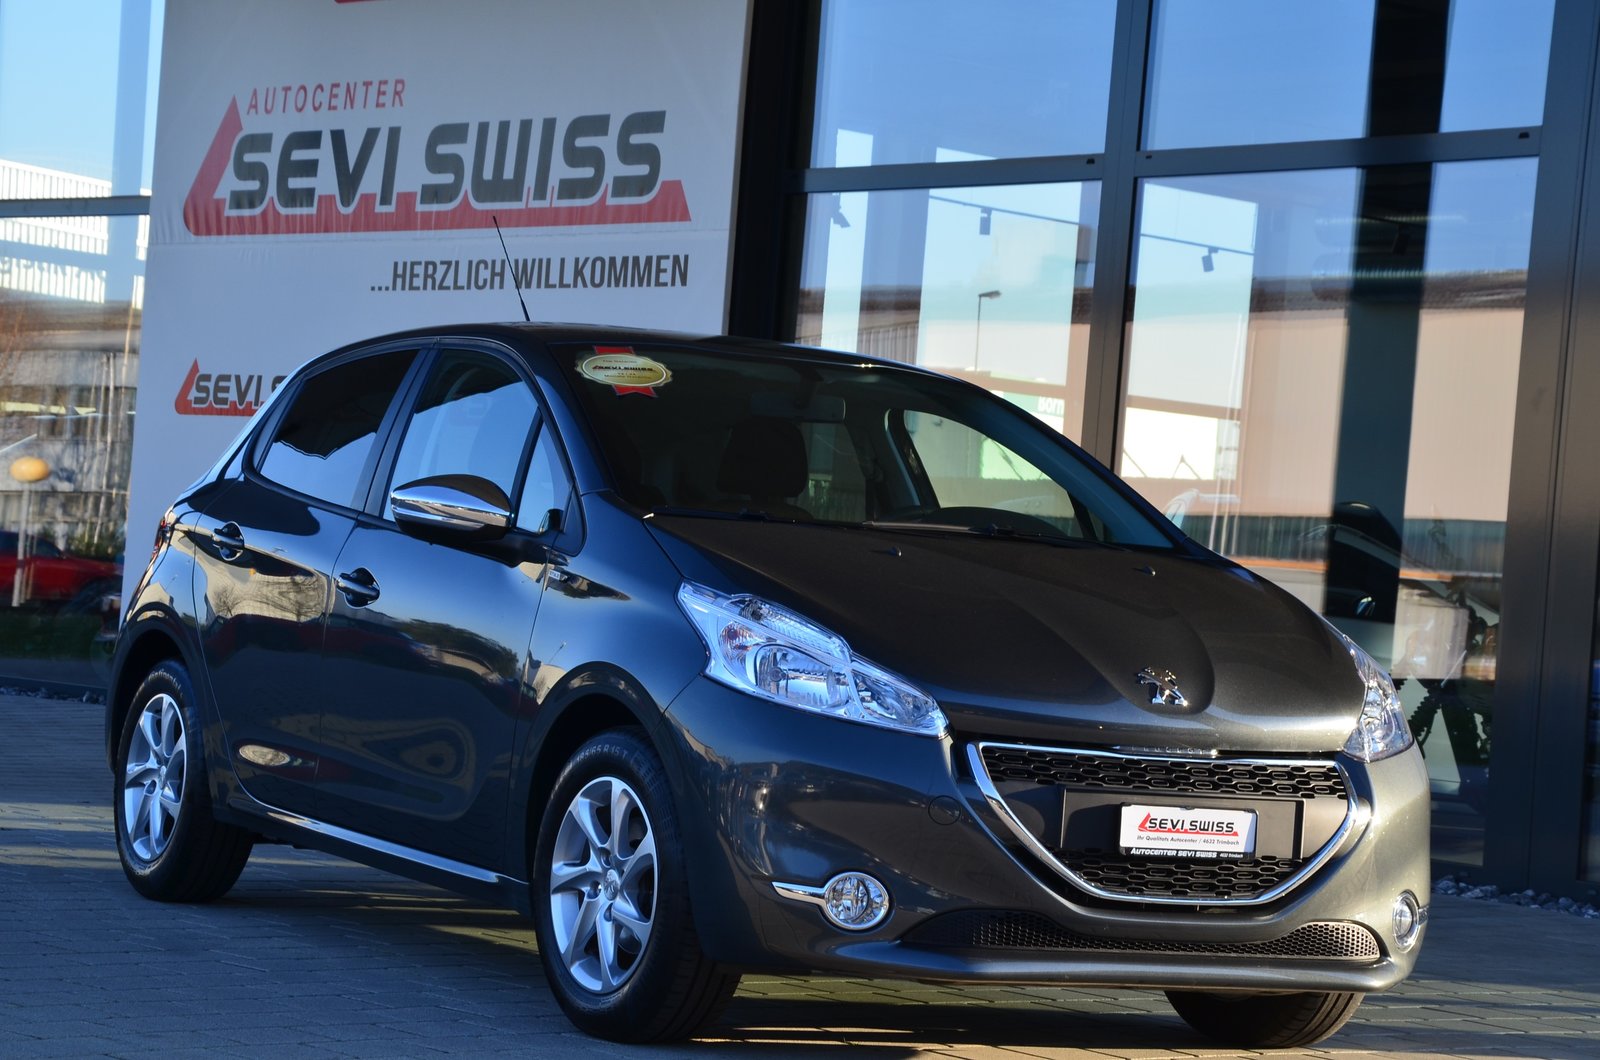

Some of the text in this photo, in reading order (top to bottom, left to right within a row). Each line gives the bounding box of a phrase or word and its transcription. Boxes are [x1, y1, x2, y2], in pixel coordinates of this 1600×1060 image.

[246, 78, 407, 116] AUTOCENTER
[228, 110, 667, 211] SEVI SWISS
[514, 254, 690, 290] WILLKOMMEN
[193, 373, 263, 407] SEVI
[1148, 818, 1235, 834] SEVI SWISS
